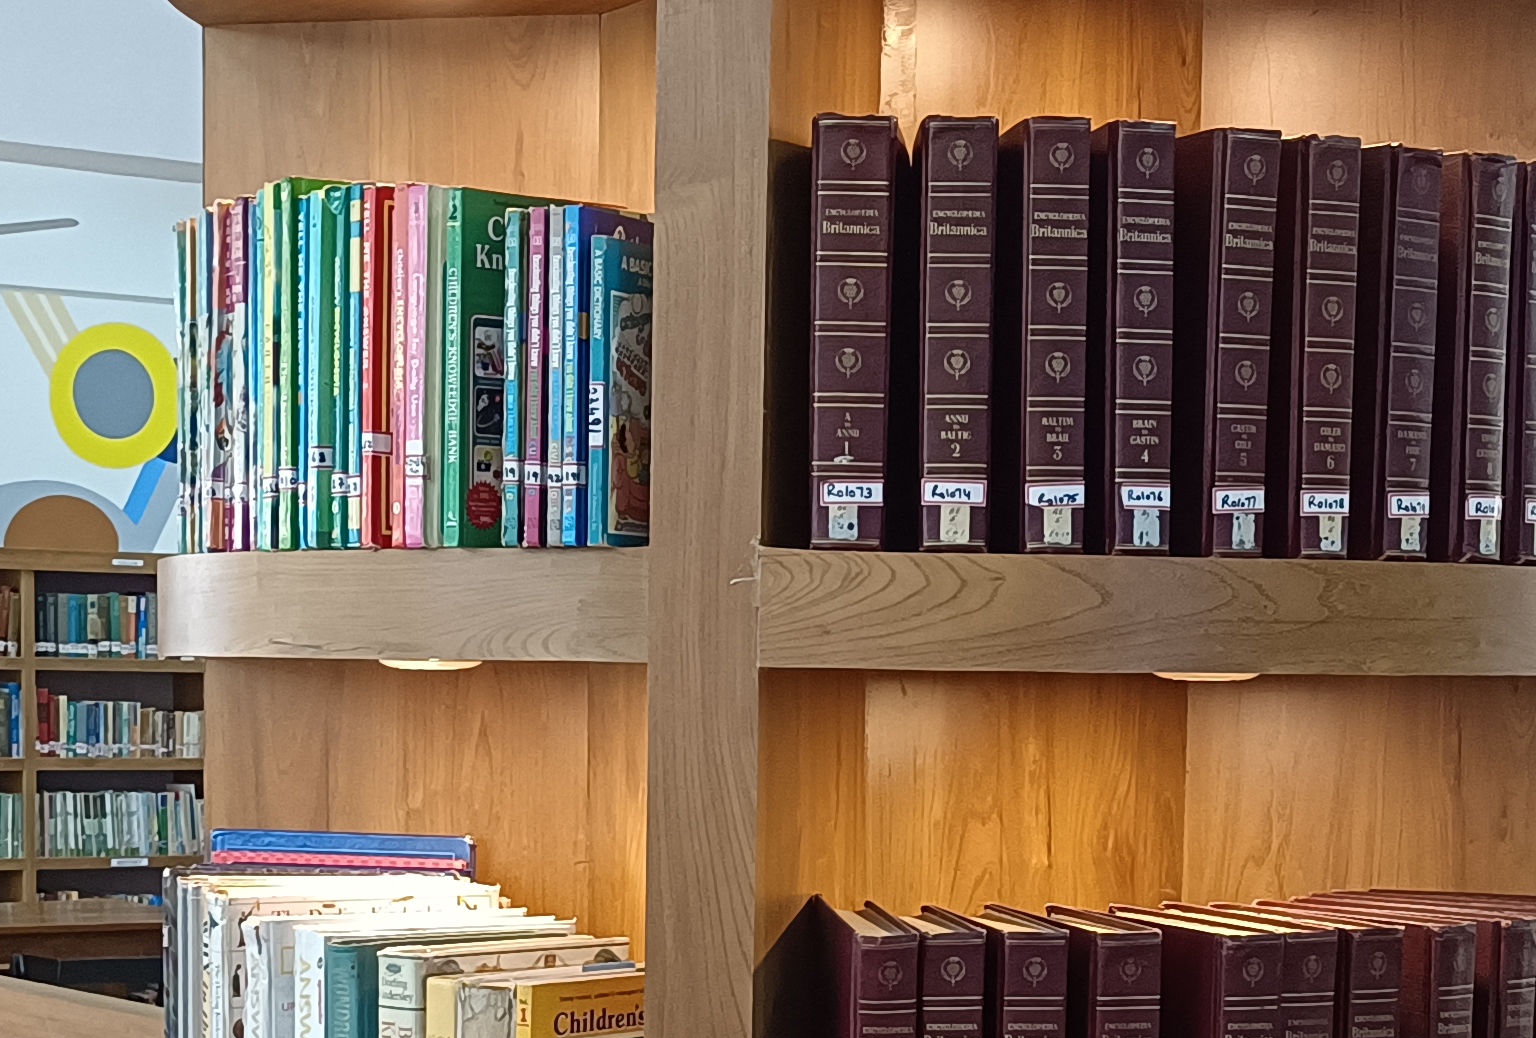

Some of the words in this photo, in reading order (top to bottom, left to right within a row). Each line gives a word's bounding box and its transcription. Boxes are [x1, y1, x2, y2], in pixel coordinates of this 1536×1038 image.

[822, 220, 880, 236] Britannica
[929, 222, 987, 237] Britannica
[1031, 224, 1088, 239] Britannica
[1119, 228, 1172, 244] Britannica
[593, 286, 603, 340] DICTIONARY
[951, 444, 962, 458] 2
[1053, 446, 1062, 461] 3
[1140, 449, 1149, 463] 4
[1240, 453, 1248, 467] 5
[1326, 455, 1335, 470] 6
